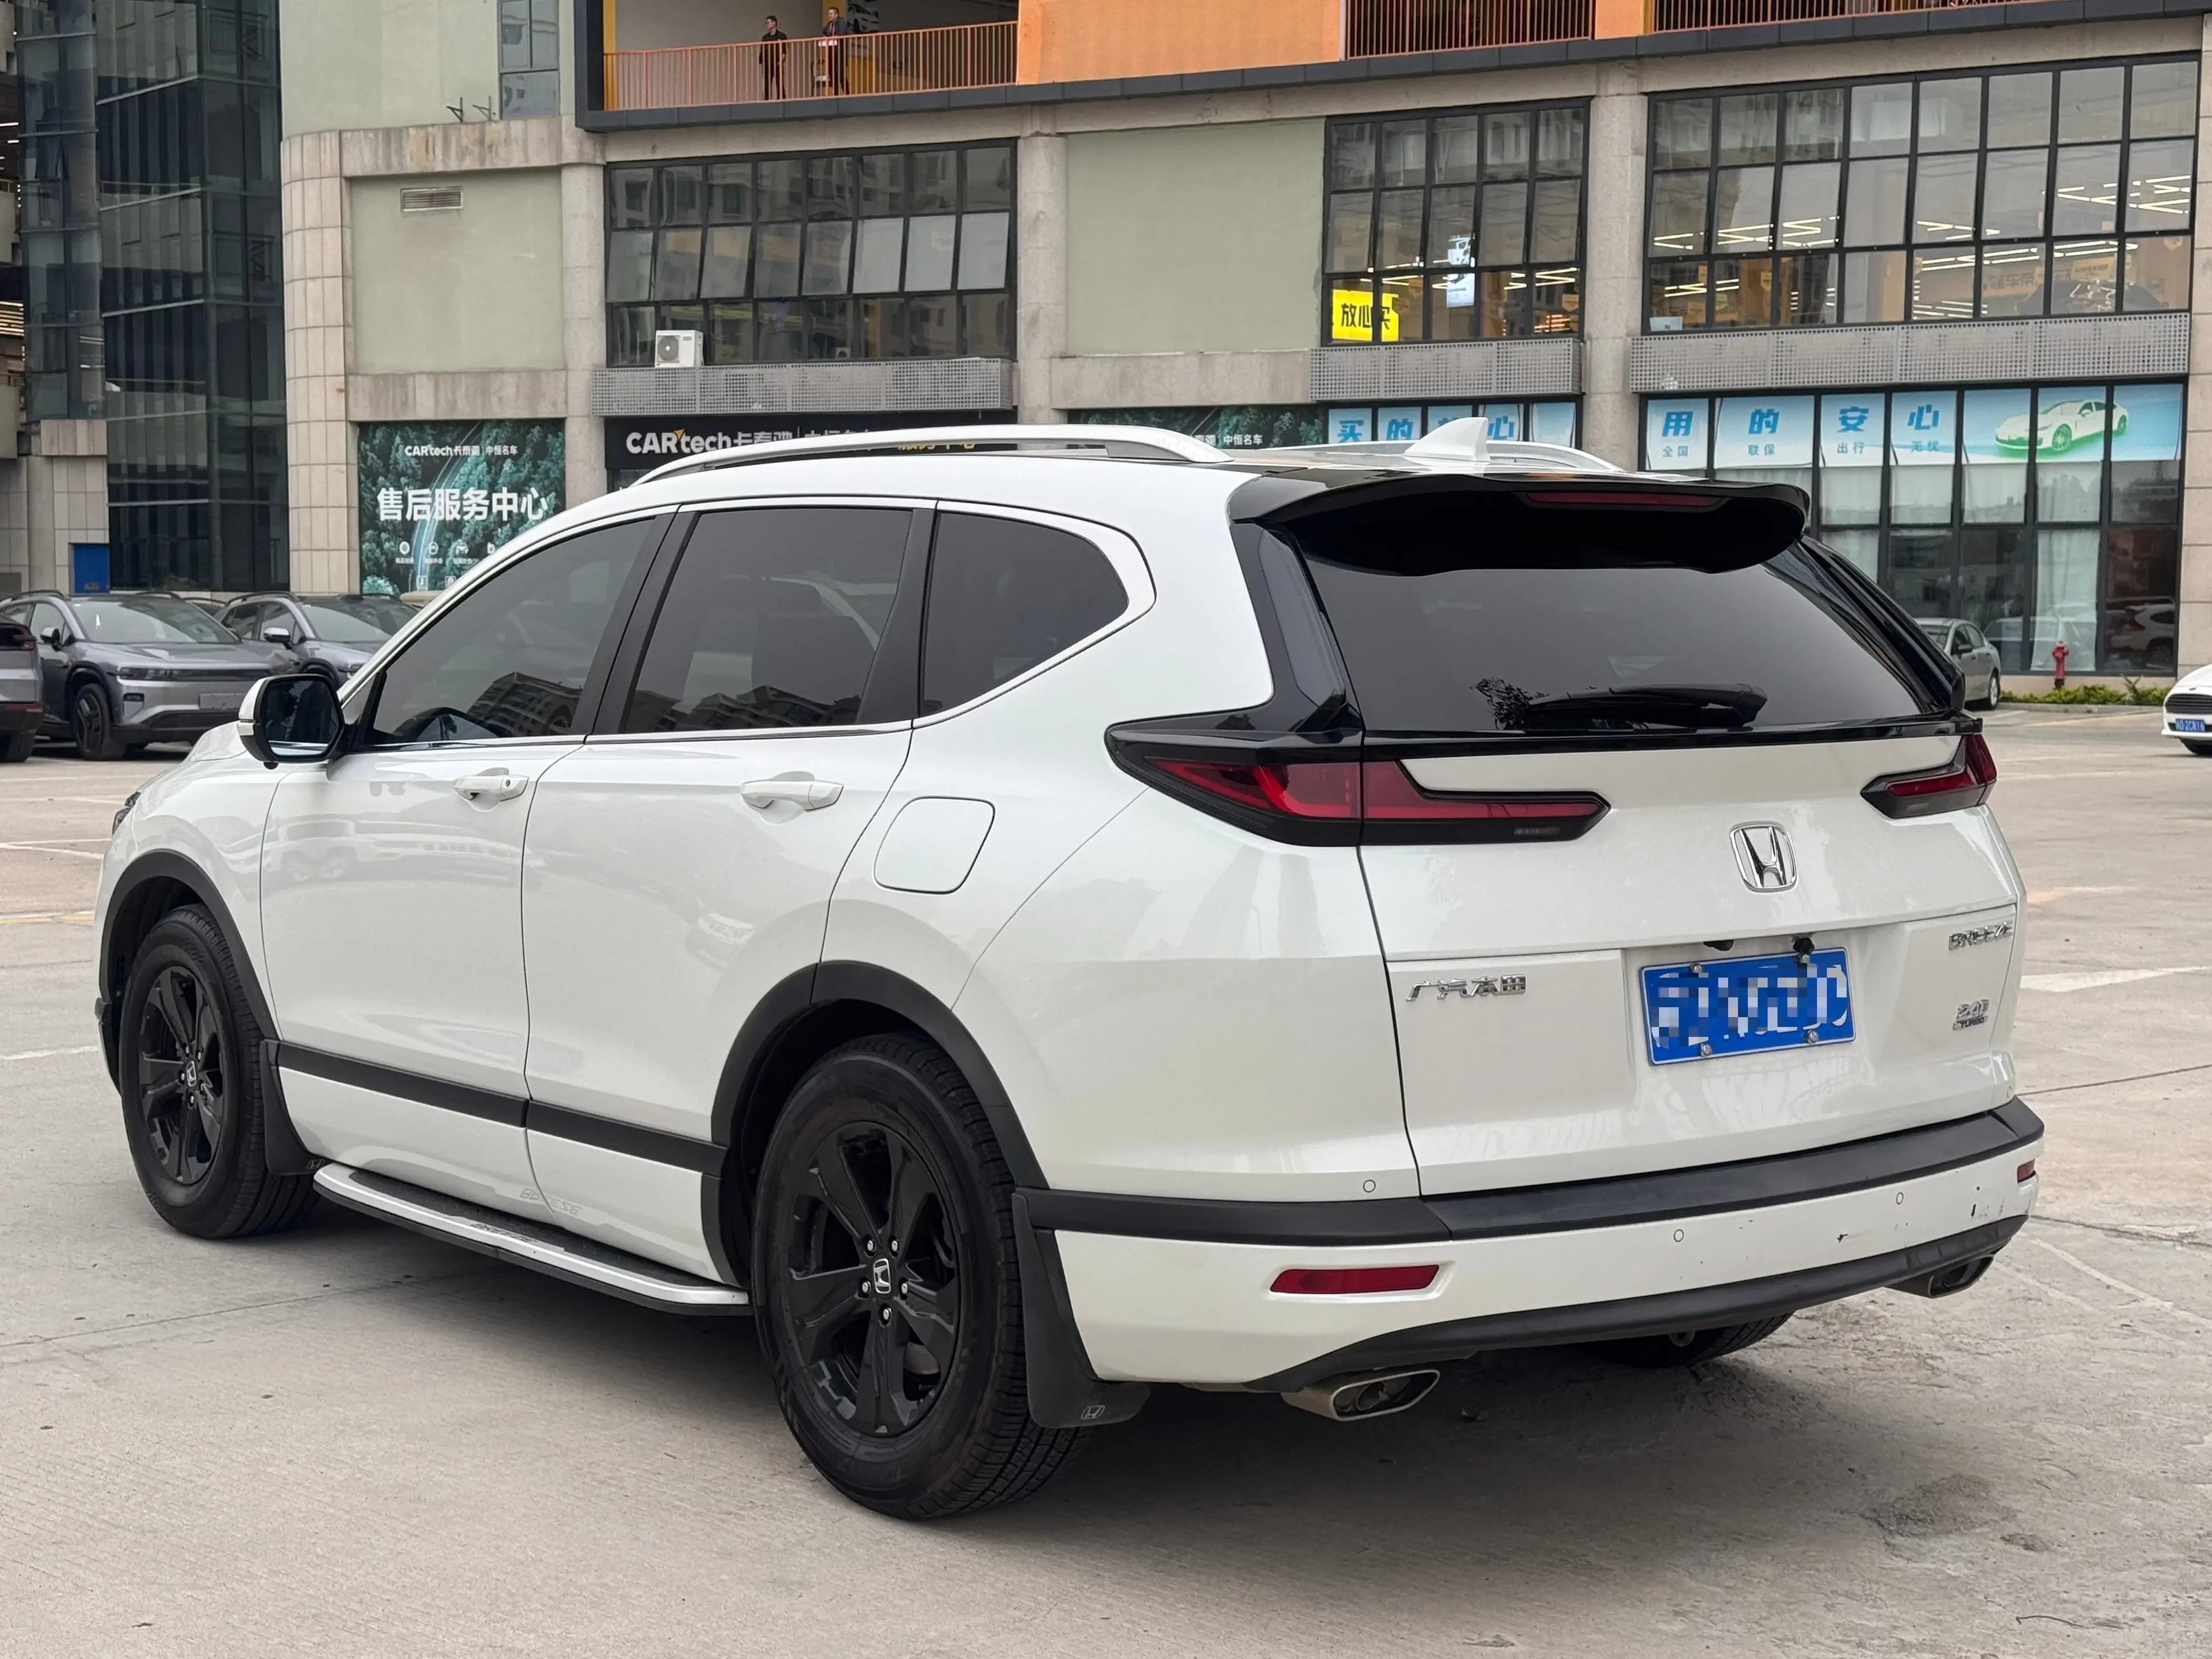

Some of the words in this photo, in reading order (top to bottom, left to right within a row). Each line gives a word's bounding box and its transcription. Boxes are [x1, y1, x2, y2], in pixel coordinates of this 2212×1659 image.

[376, 487, 549, 521] 售后服务中心
